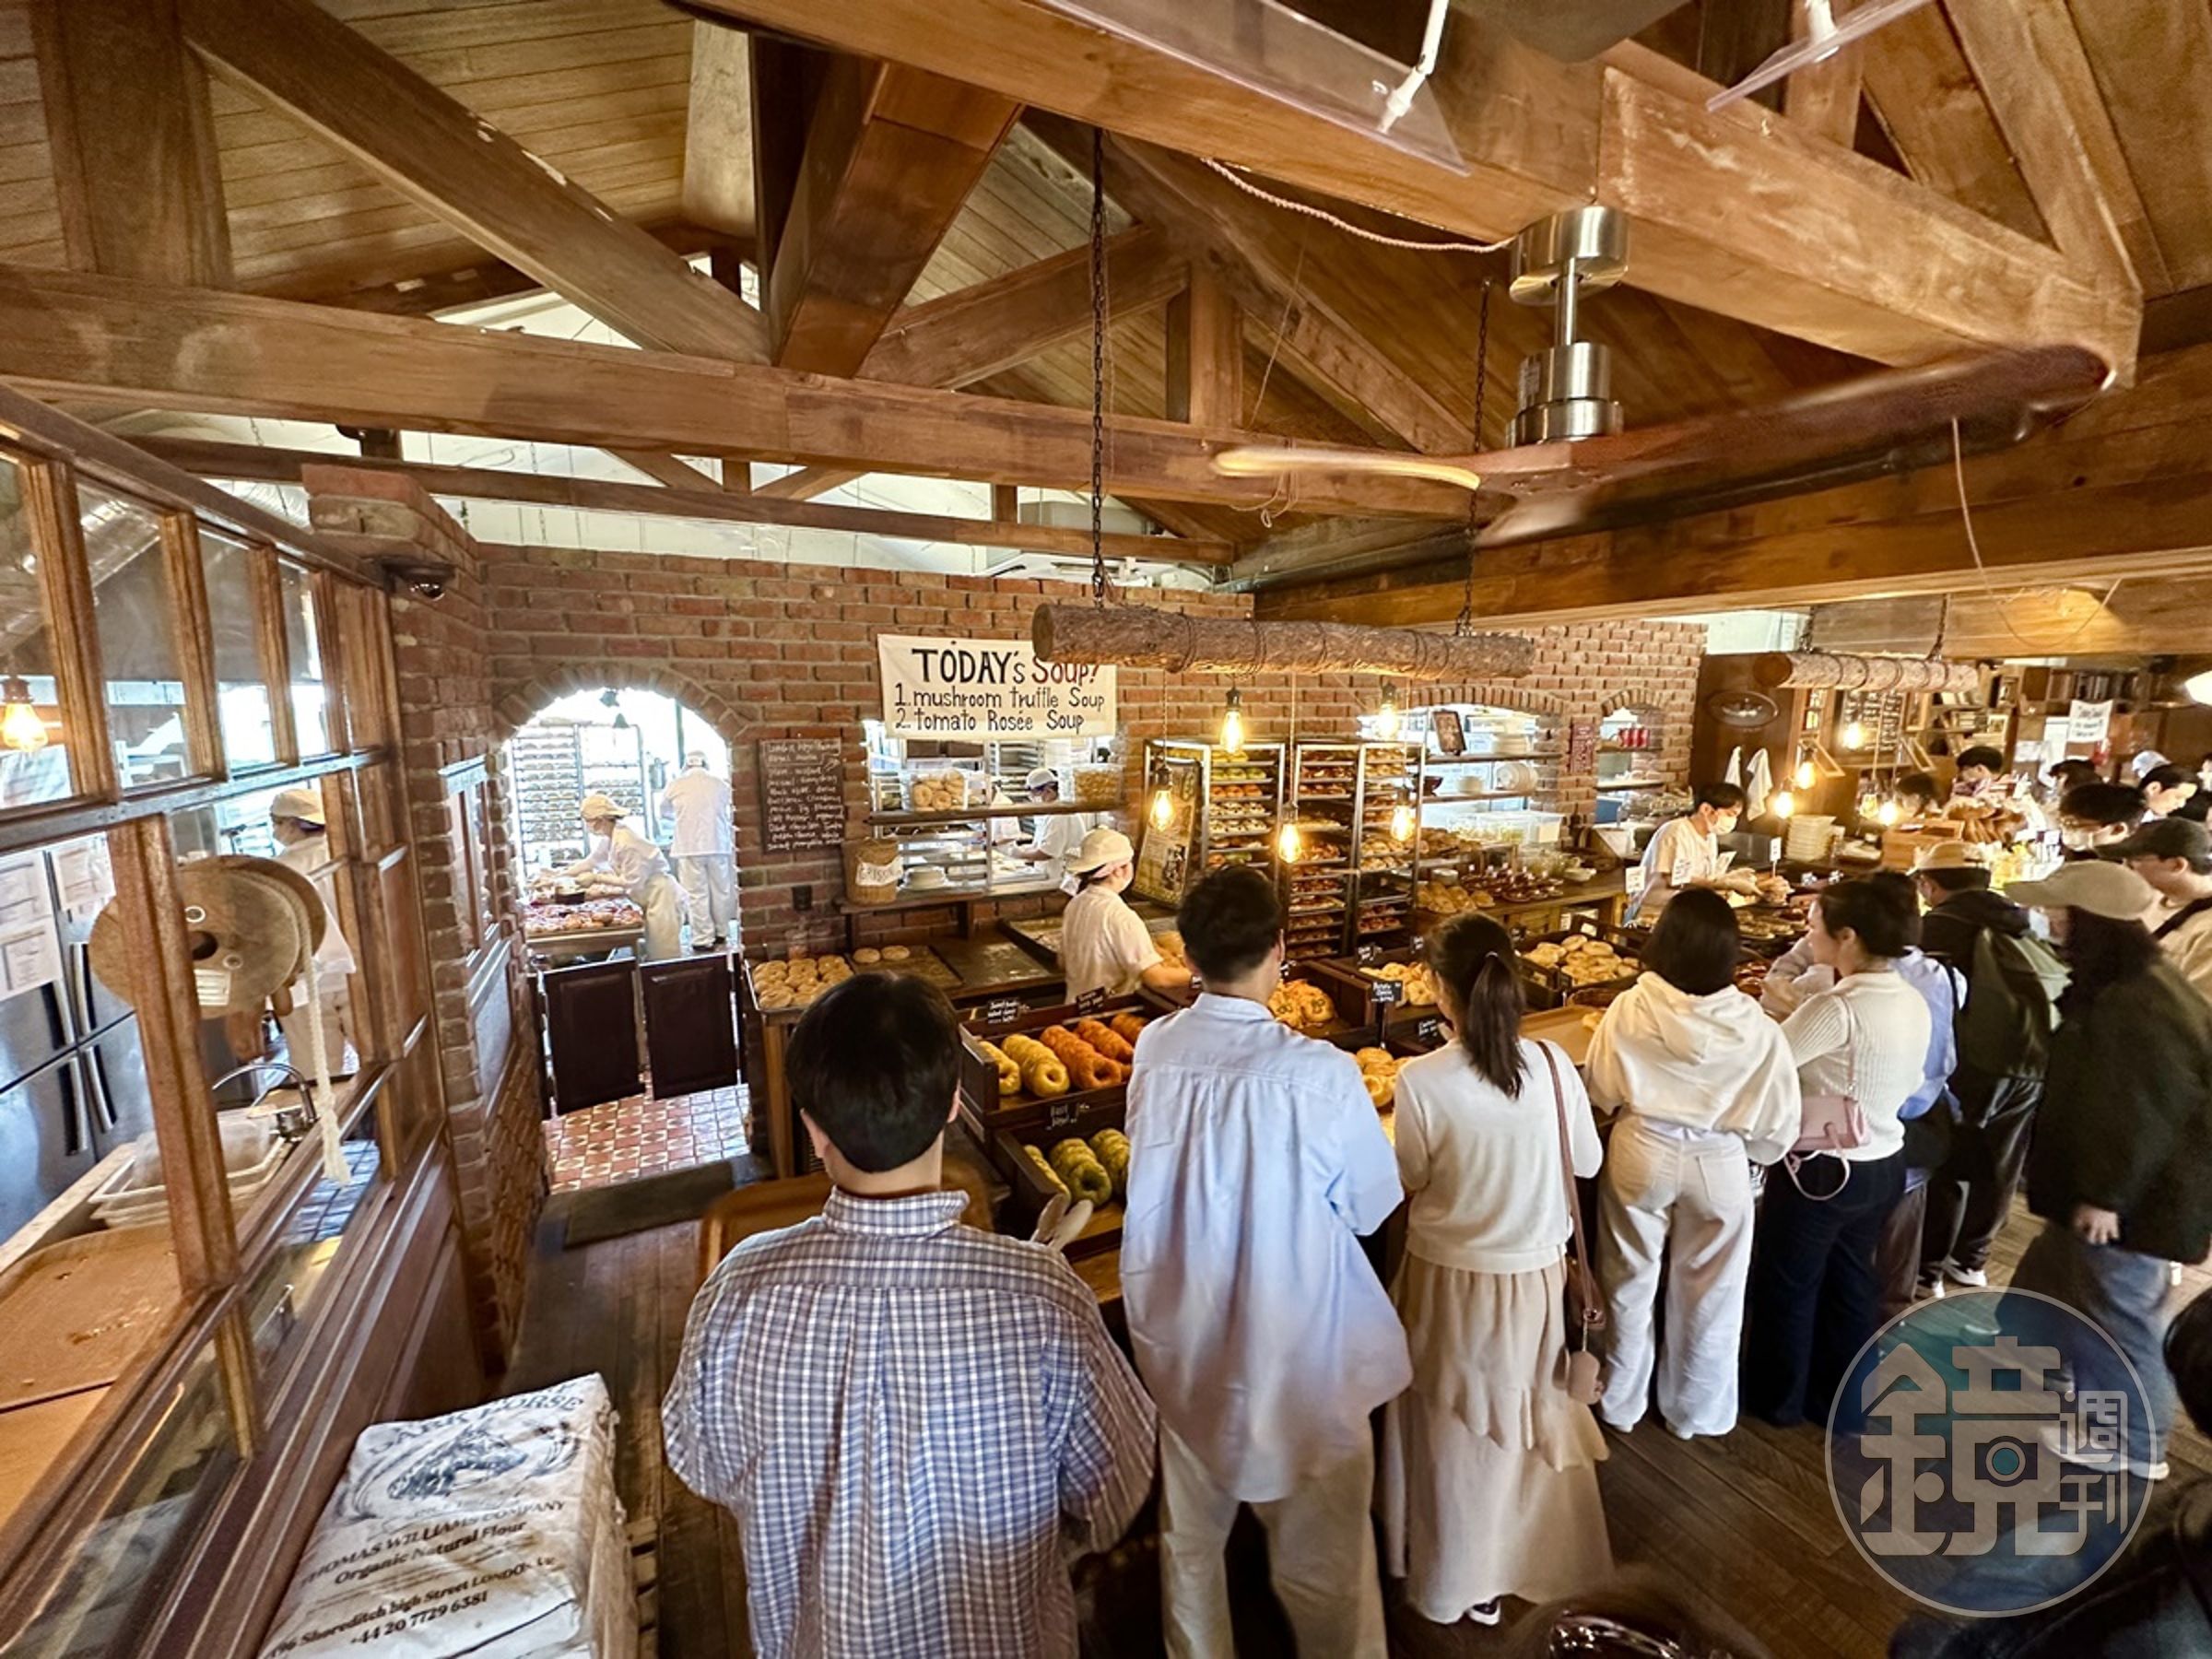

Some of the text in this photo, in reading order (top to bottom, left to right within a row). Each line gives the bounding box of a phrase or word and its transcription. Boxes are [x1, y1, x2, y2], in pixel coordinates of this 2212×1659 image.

[912, 648, 1100, 687] TODAY's Soup!
[894, 683, 1105, 712] 1. mushroom truffle Soup
[895, 708, 1085, 735] 2. tomato Rosée Soup
[335, 1521, 527, 1584] Organic Natural Flour
[300, 1606, 386, 1644] Shoreditch
[423, 1580, 469, 1604] Street
[383, 1619, 406, 1636] 20
[410, 1605, 449, 1628] 7729
[450, 1590, 488, 1613] 6381
